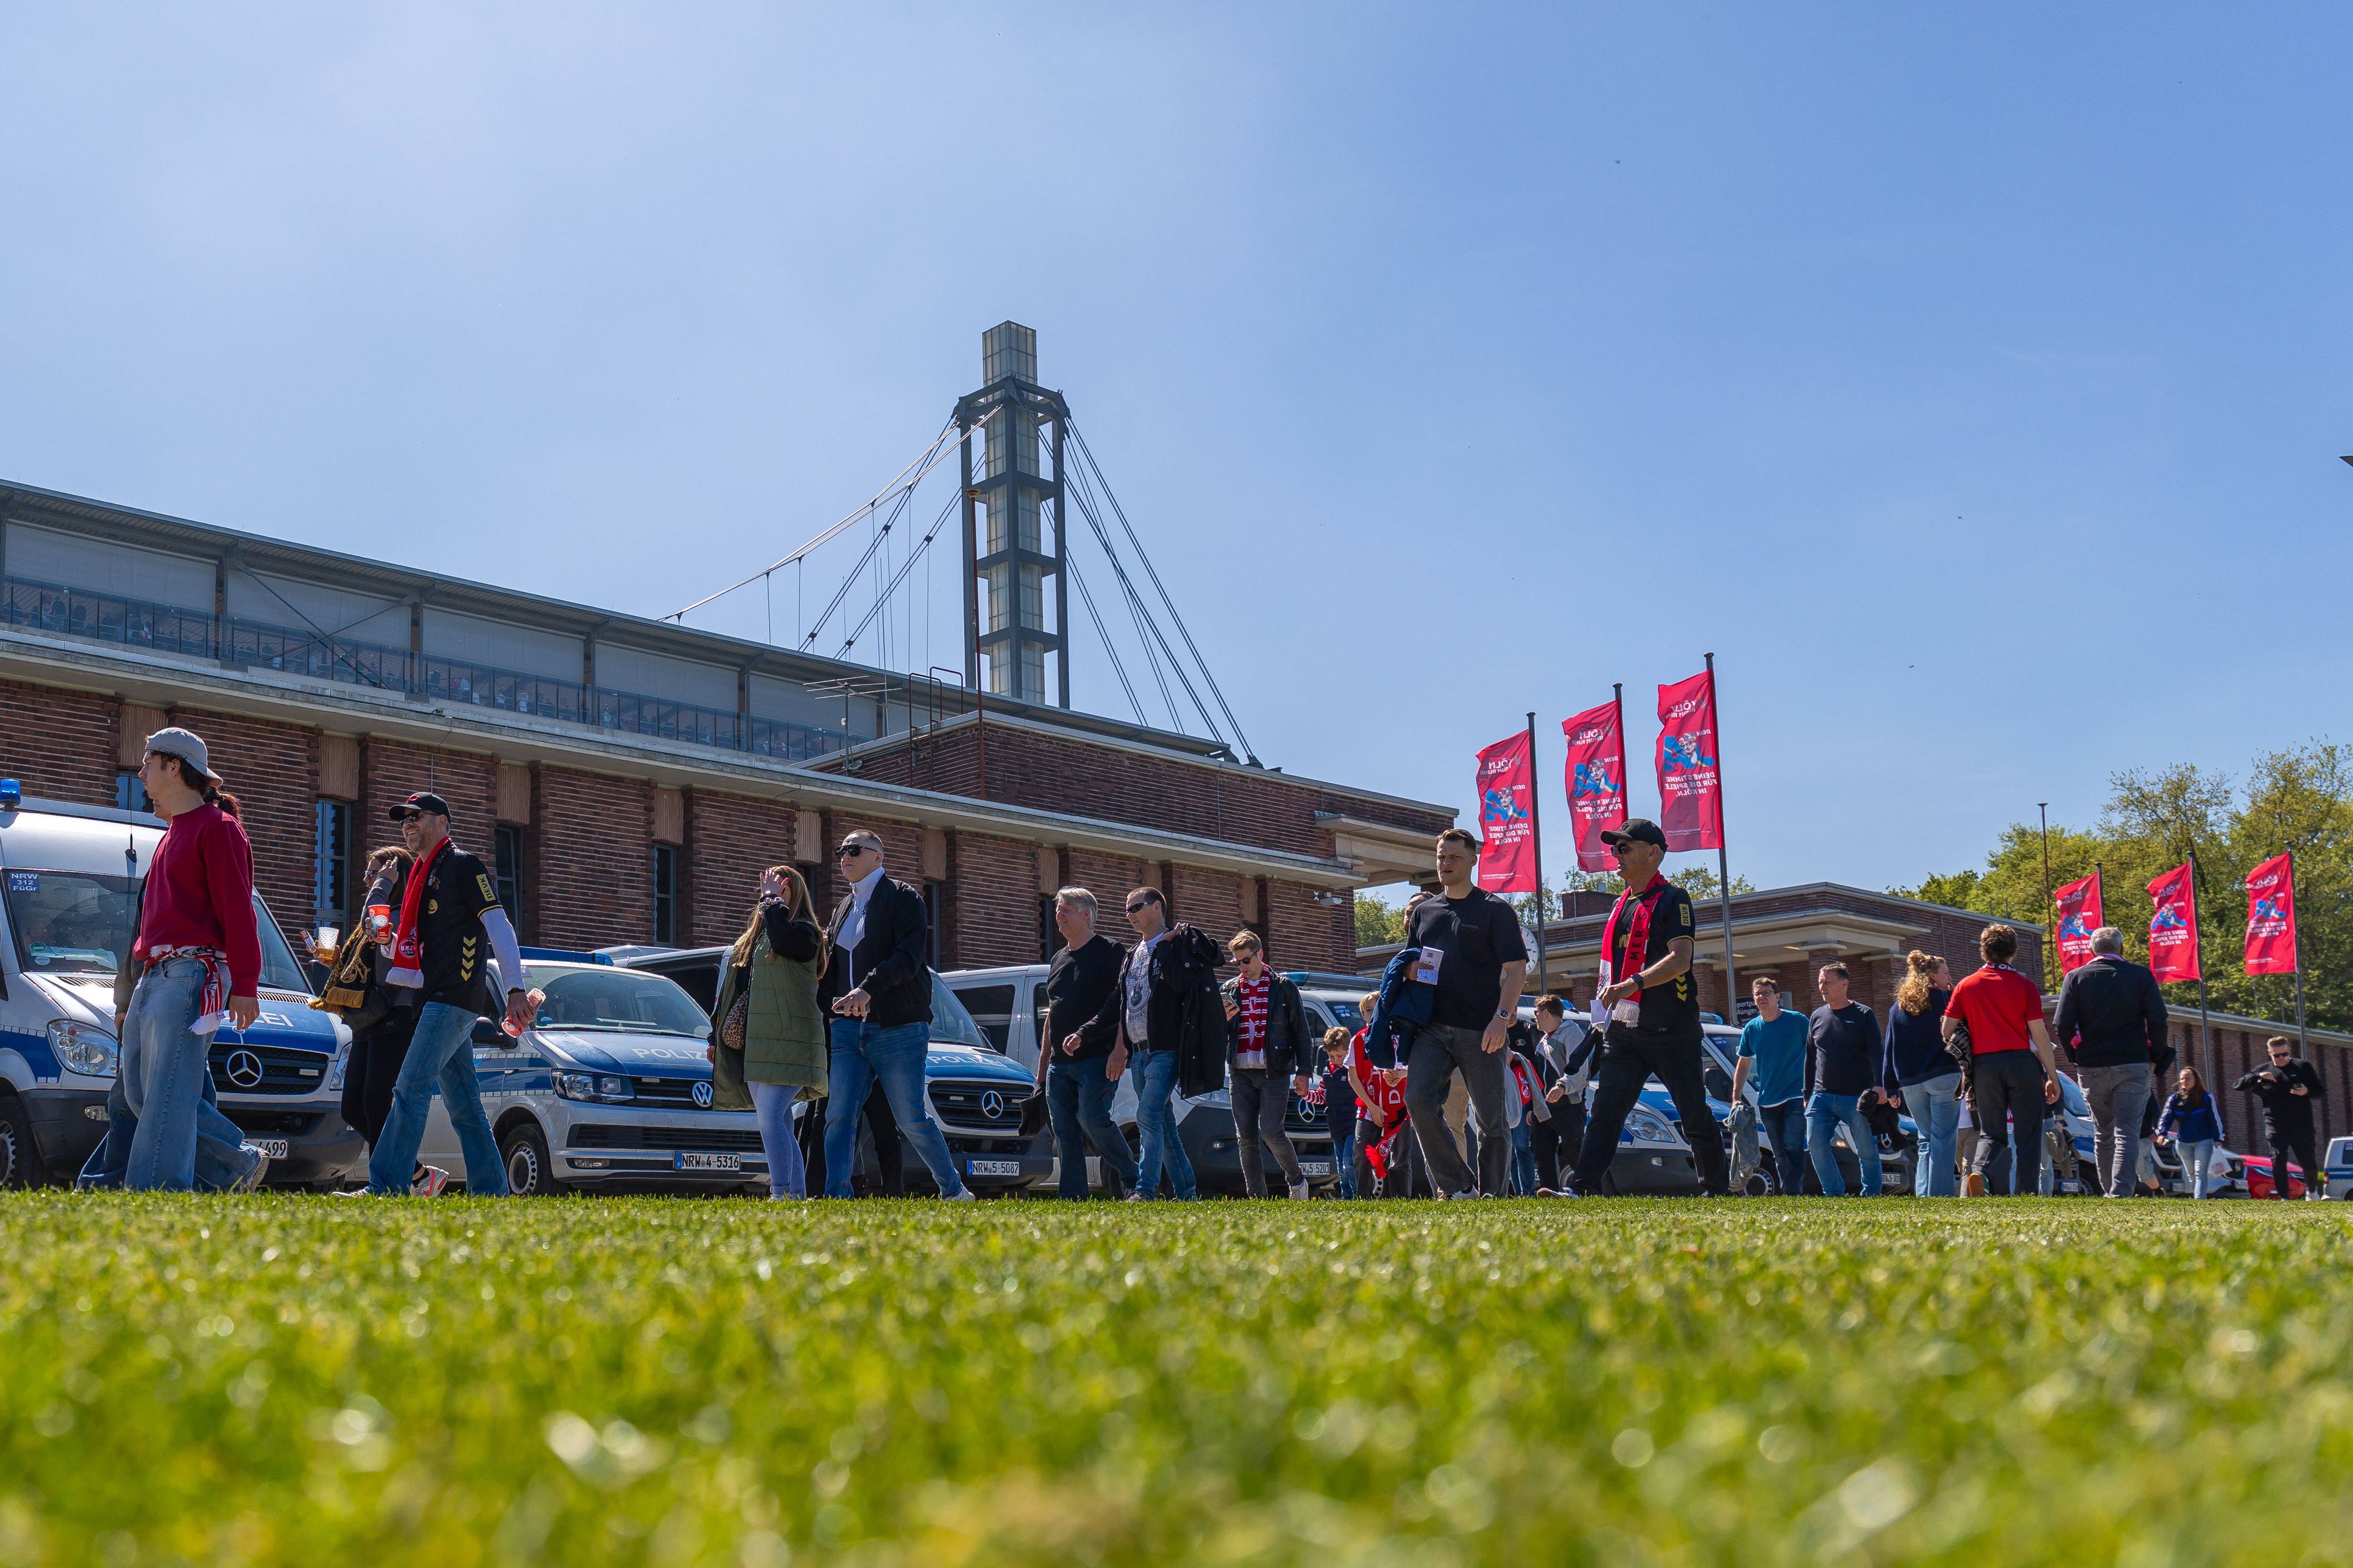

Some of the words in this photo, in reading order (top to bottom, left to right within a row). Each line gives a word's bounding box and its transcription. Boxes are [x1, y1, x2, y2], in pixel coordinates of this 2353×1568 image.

[479, 877, 493, 899] DEVK
[1736, 1000, 1756, 1009] portpa
[631, 1048, 707, 1060] POLIZ
[926, 1056, 1008, 1069] POLIZEI
[682, 1155, 701, 1167] NRW
[706, 1155, 739, 1168] 4-5316
[973, 1162, 988, 1173] NRW
[992, 1162, 1018, 1174] 5-5087
[1309, 1164, 1329, 1174] 5-5201
